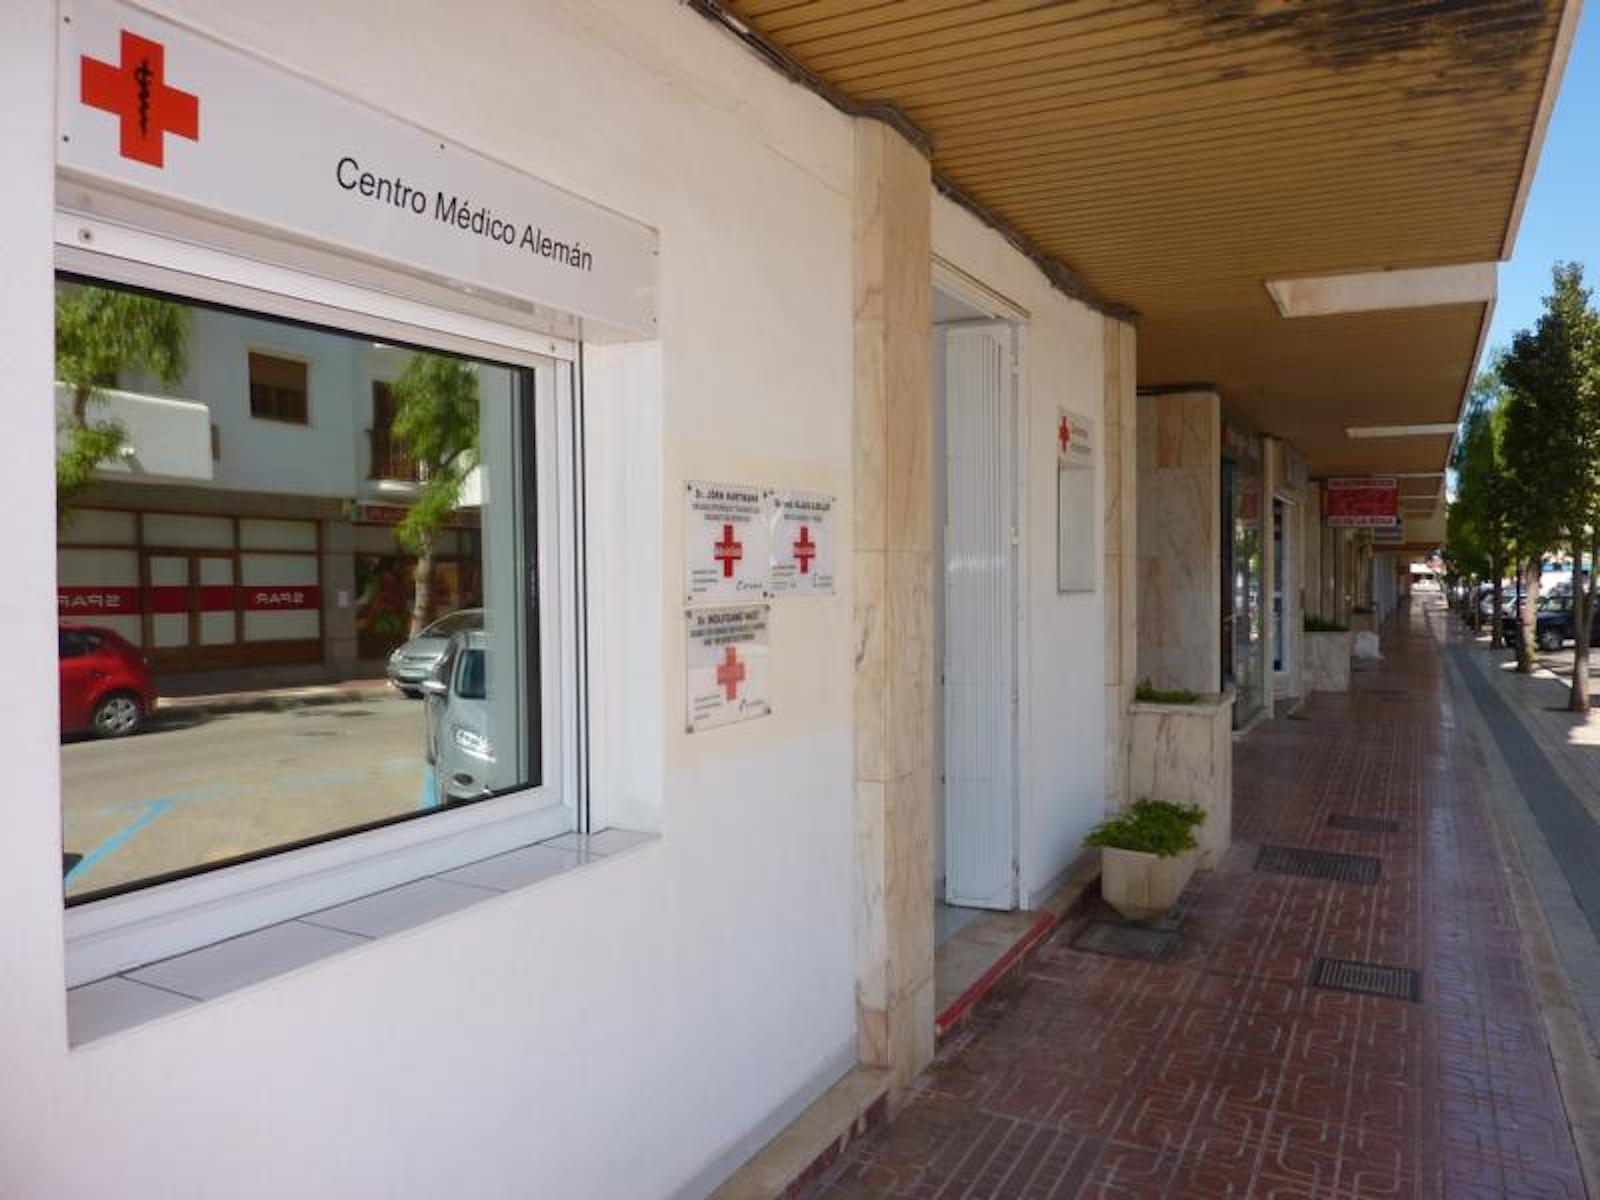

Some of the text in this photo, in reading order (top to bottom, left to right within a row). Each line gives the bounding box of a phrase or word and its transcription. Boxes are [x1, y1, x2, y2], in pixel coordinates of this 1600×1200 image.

[336, 157, 594, 272] Centro Médico Alemán
